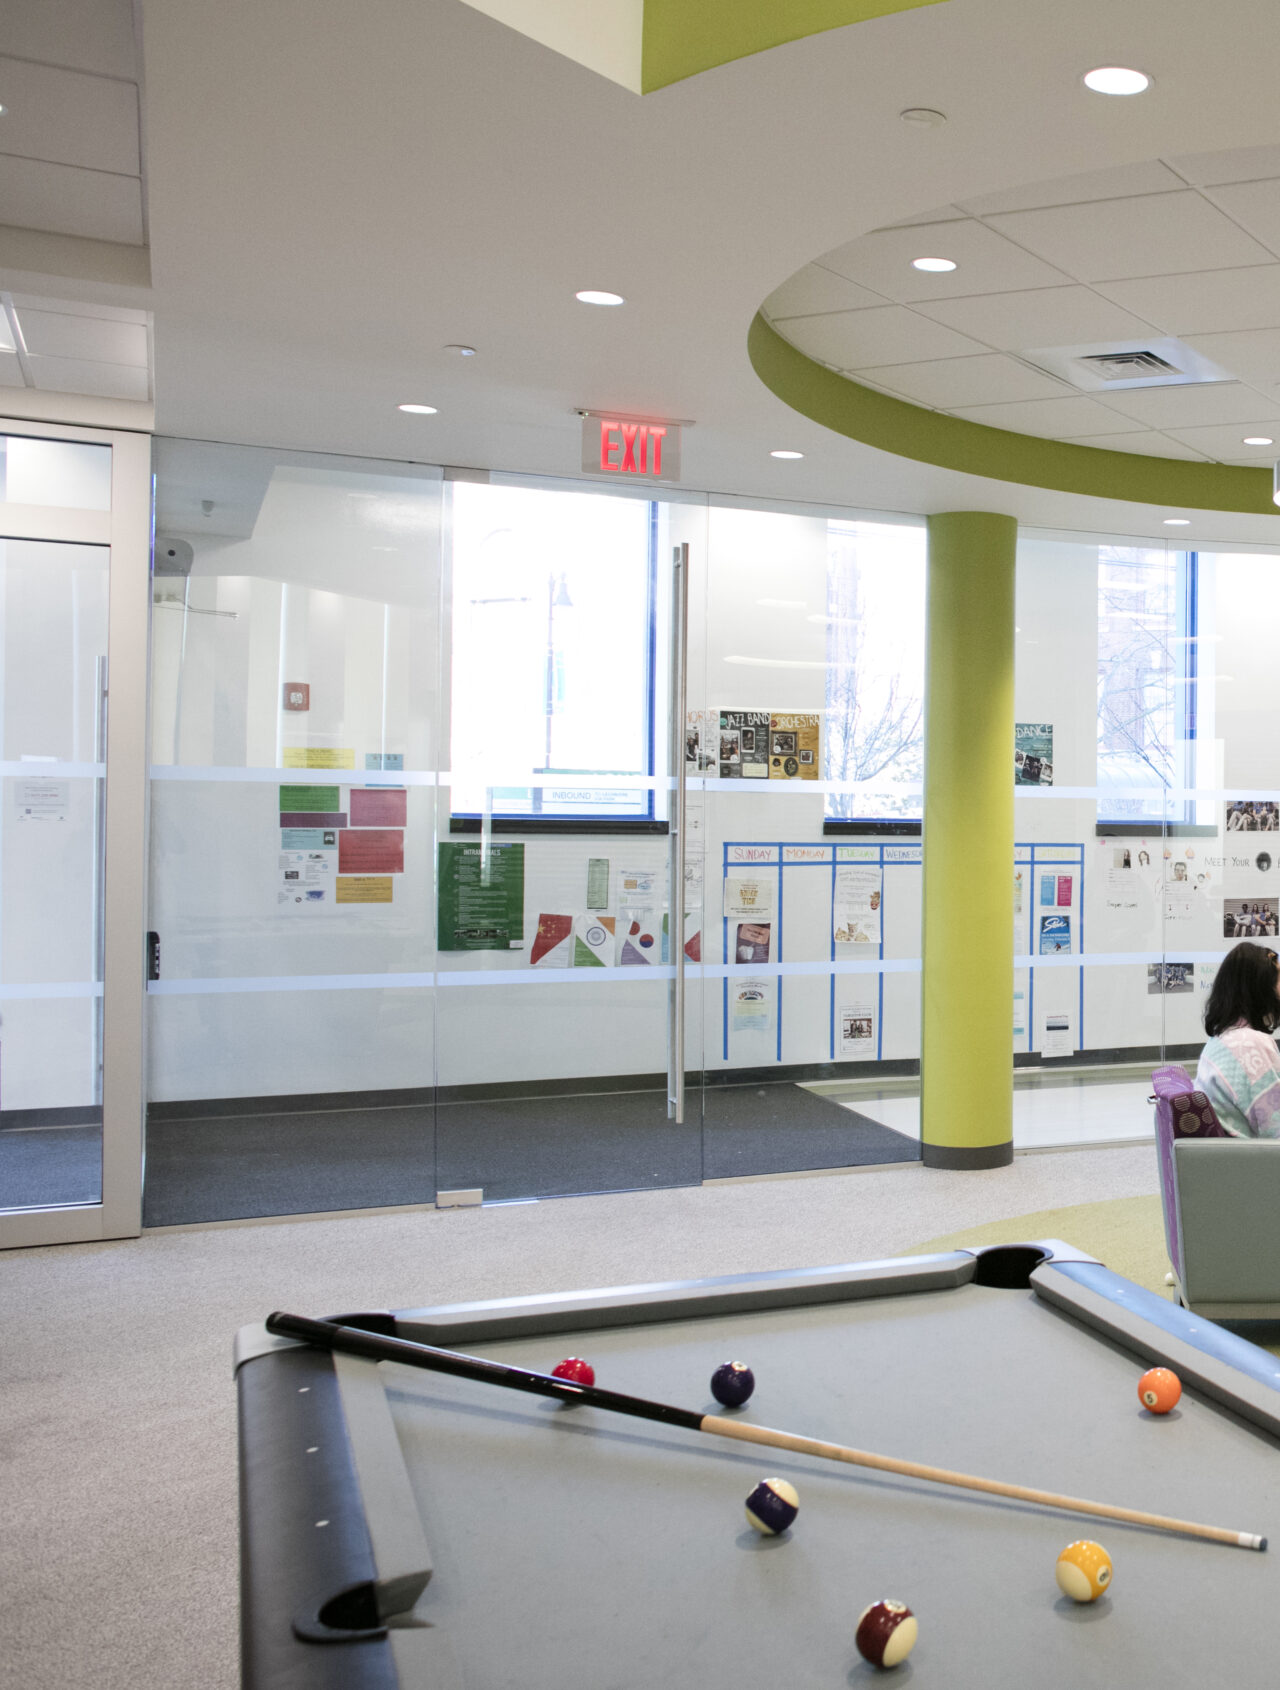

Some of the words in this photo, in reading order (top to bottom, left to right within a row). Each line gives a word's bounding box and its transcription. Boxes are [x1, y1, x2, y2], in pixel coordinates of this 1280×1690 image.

[600, 420, 667, 475] EXIT
[726, 713, 746, 730] JAZZ
[747, 711, 770, 727] BAND
[776, 713, 820, 729] ORCHESTRA
[1016, 724, 1053, 738] DANCE
[552, 791, 591, 800] INBOUND
[734, 848, 771, 860] SUNDAY
[786, 849, 825, 859] MONDAY
[1205, 857, 1226, 867] MEET
[1231, 857, 1250, 867] YOUR
